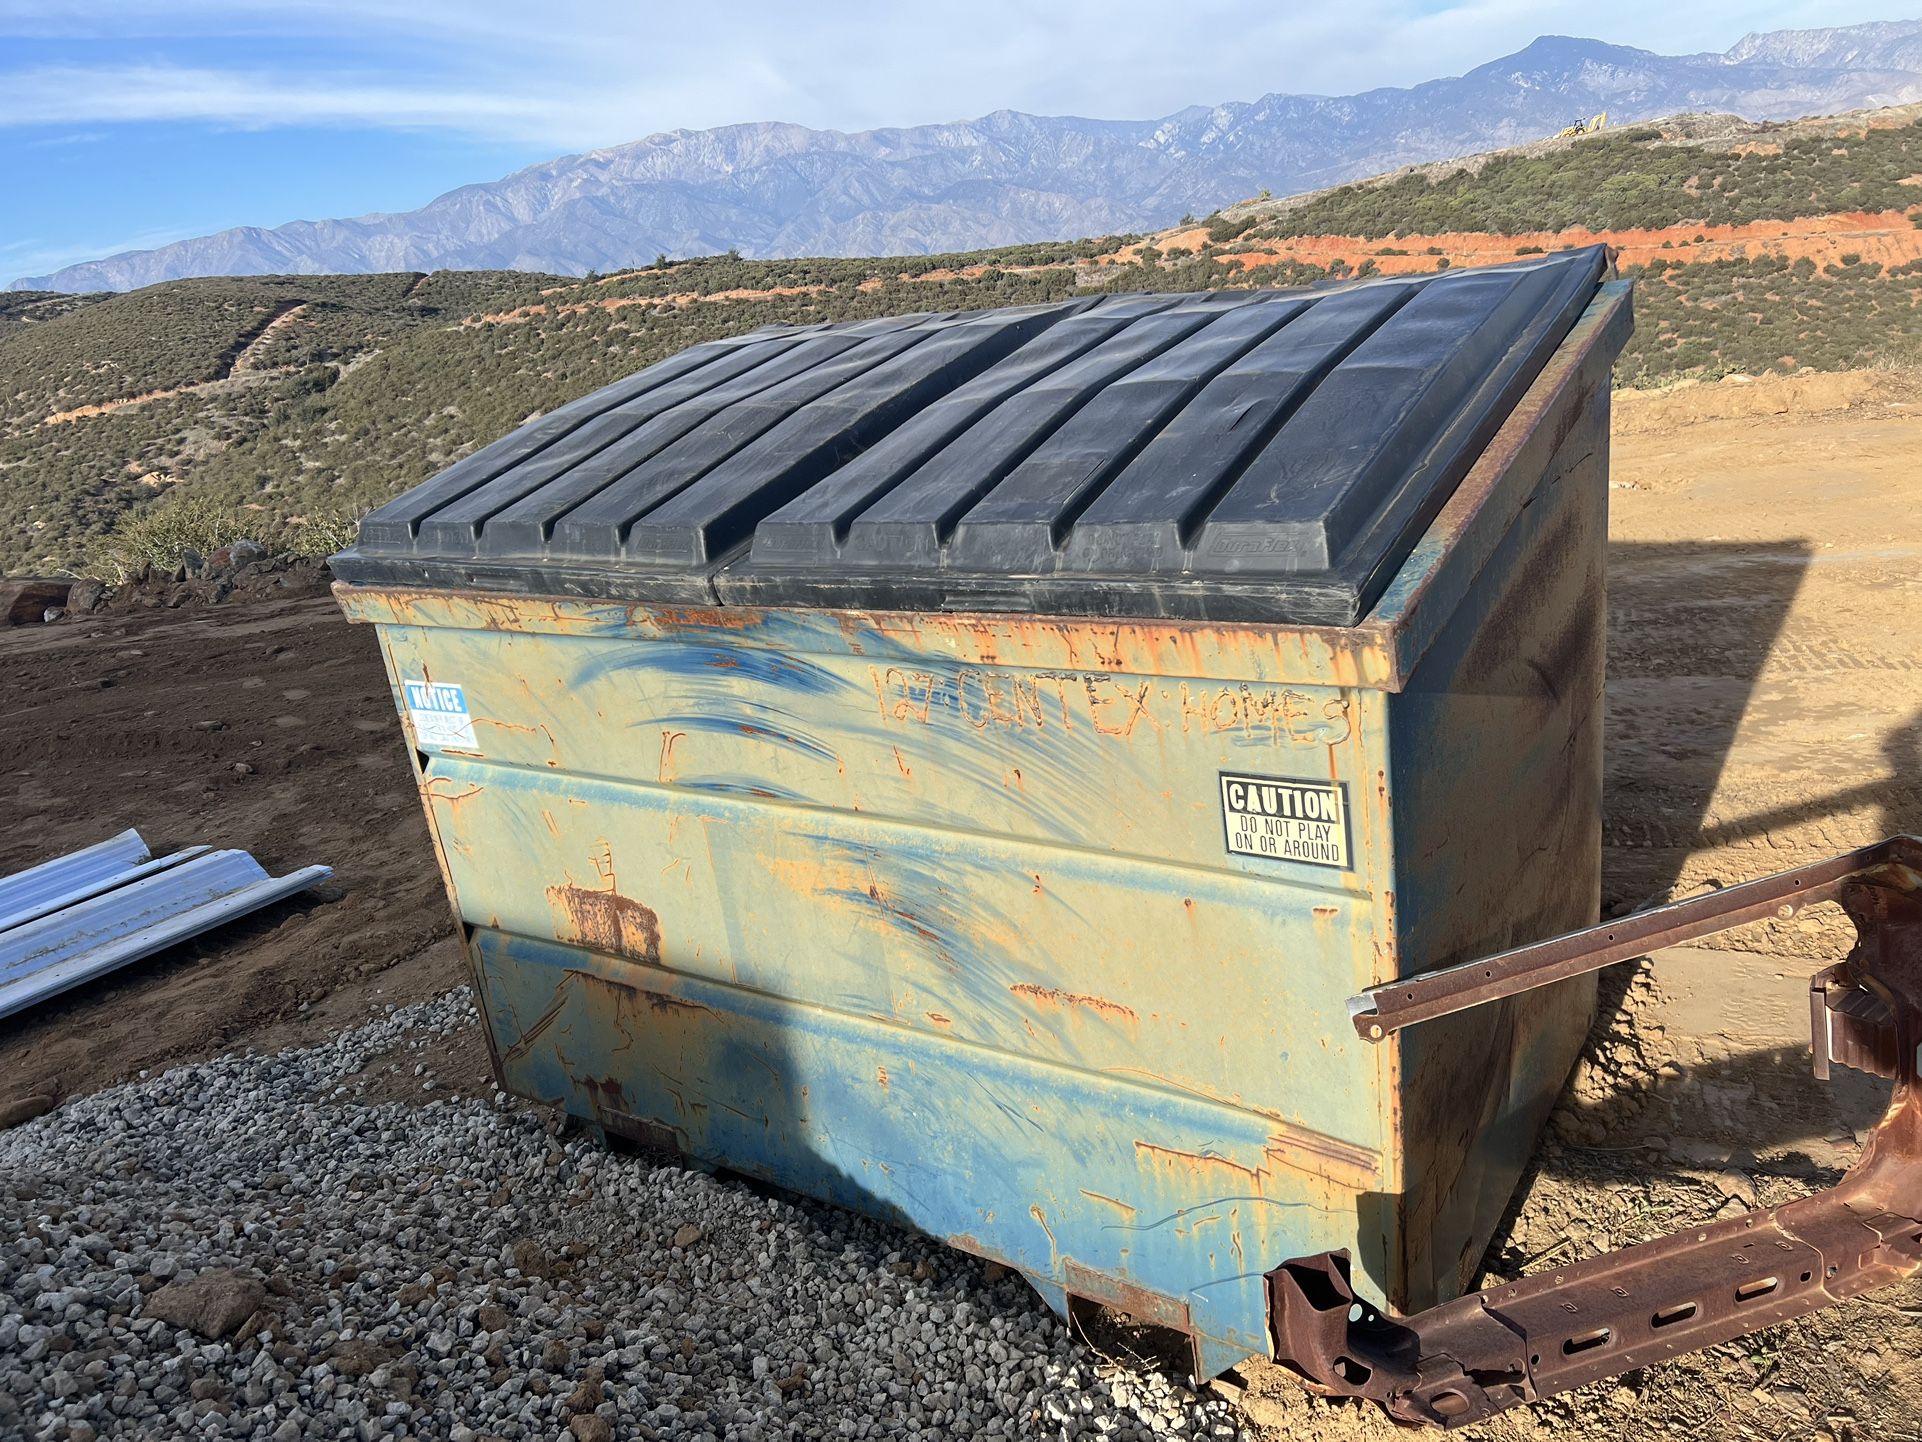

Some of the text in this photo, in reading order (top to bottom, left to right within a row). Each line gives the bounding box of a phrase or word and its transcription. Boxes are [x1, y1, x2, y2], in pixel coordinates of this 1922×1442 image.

[410, 686, 463, 713] NOTICE
[958, 668, 1162, 736] CENTEX
[1179, 682, 1351, 747] HOMES
[1229, 783, 1337, 821] CAUTION
[1240, 815, 1331, 843] DO NOT PLAY
[1235, 832, 1340, 862] ON OR AROUND
